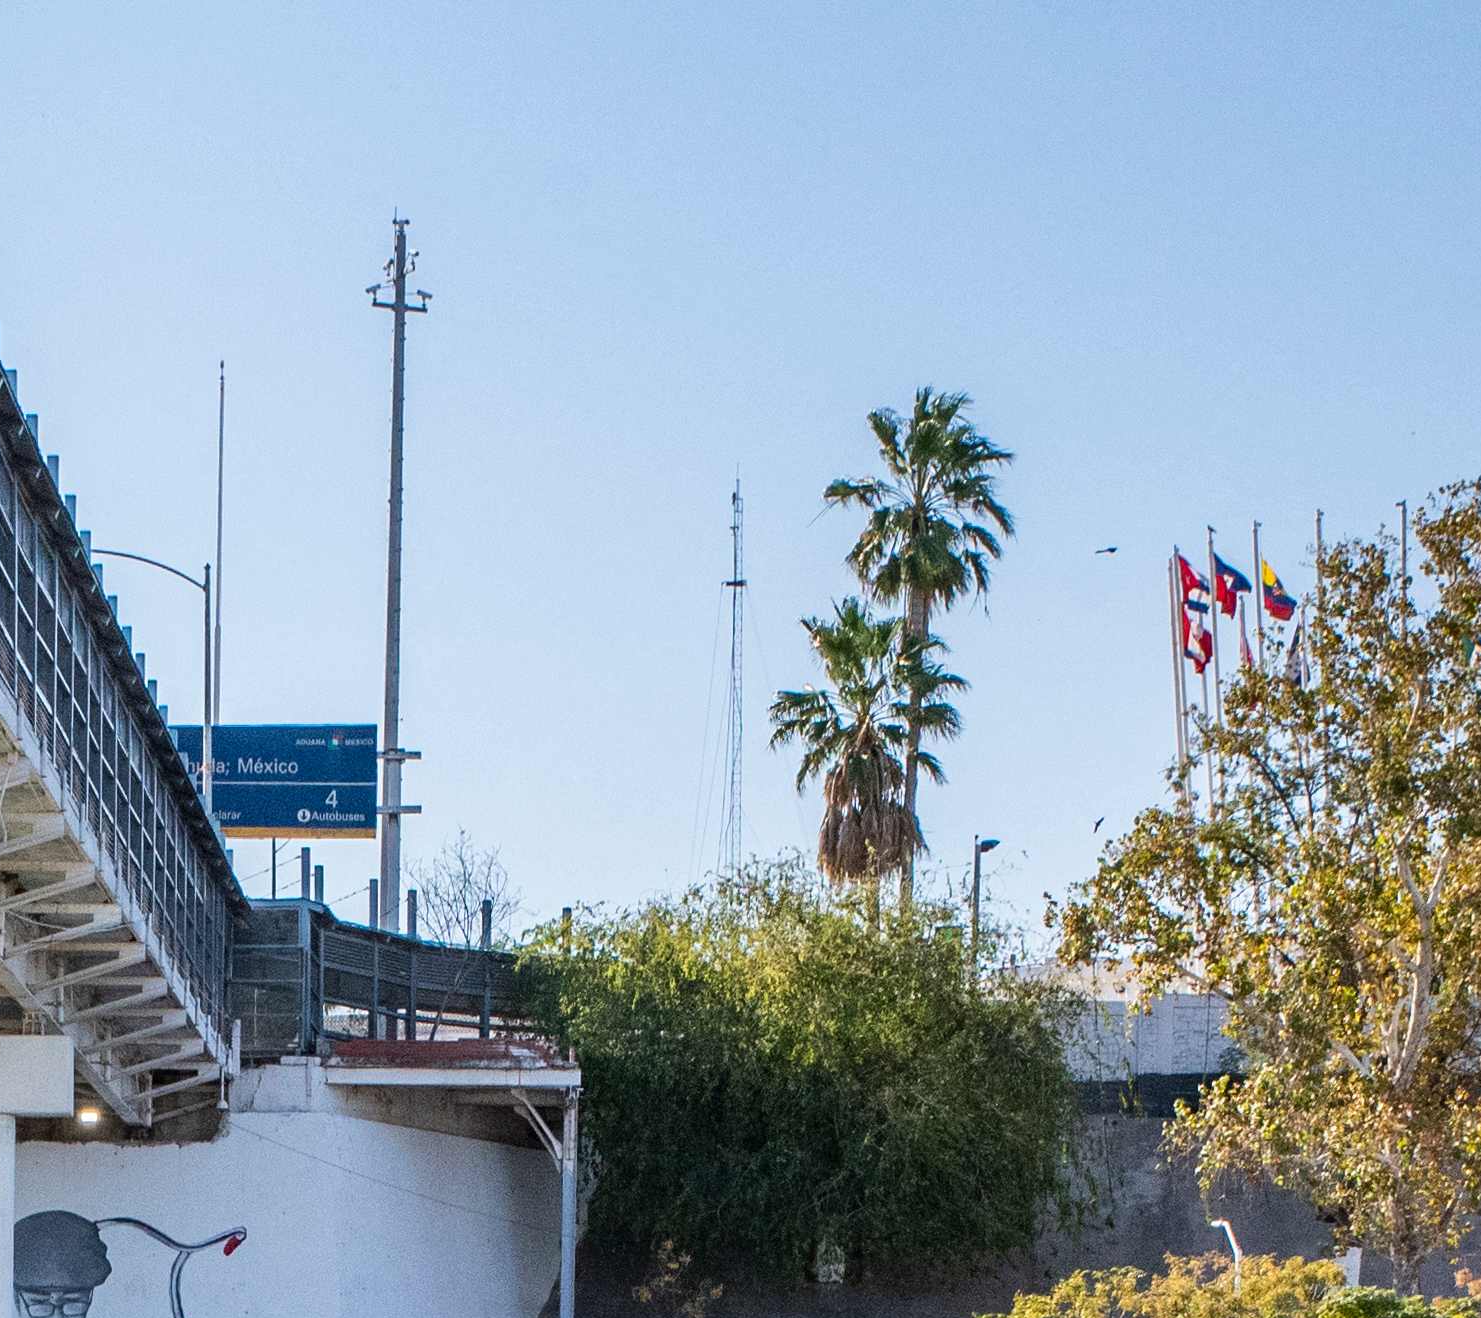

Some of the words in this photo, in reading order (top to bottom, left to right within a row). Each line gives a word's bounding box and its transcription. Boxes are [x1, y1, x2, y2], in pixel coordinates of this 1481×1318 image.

[238, 757, 299, 774] México
[325, 789, 338, 808] 4
[311, 810, 366, 822] Autobuses
